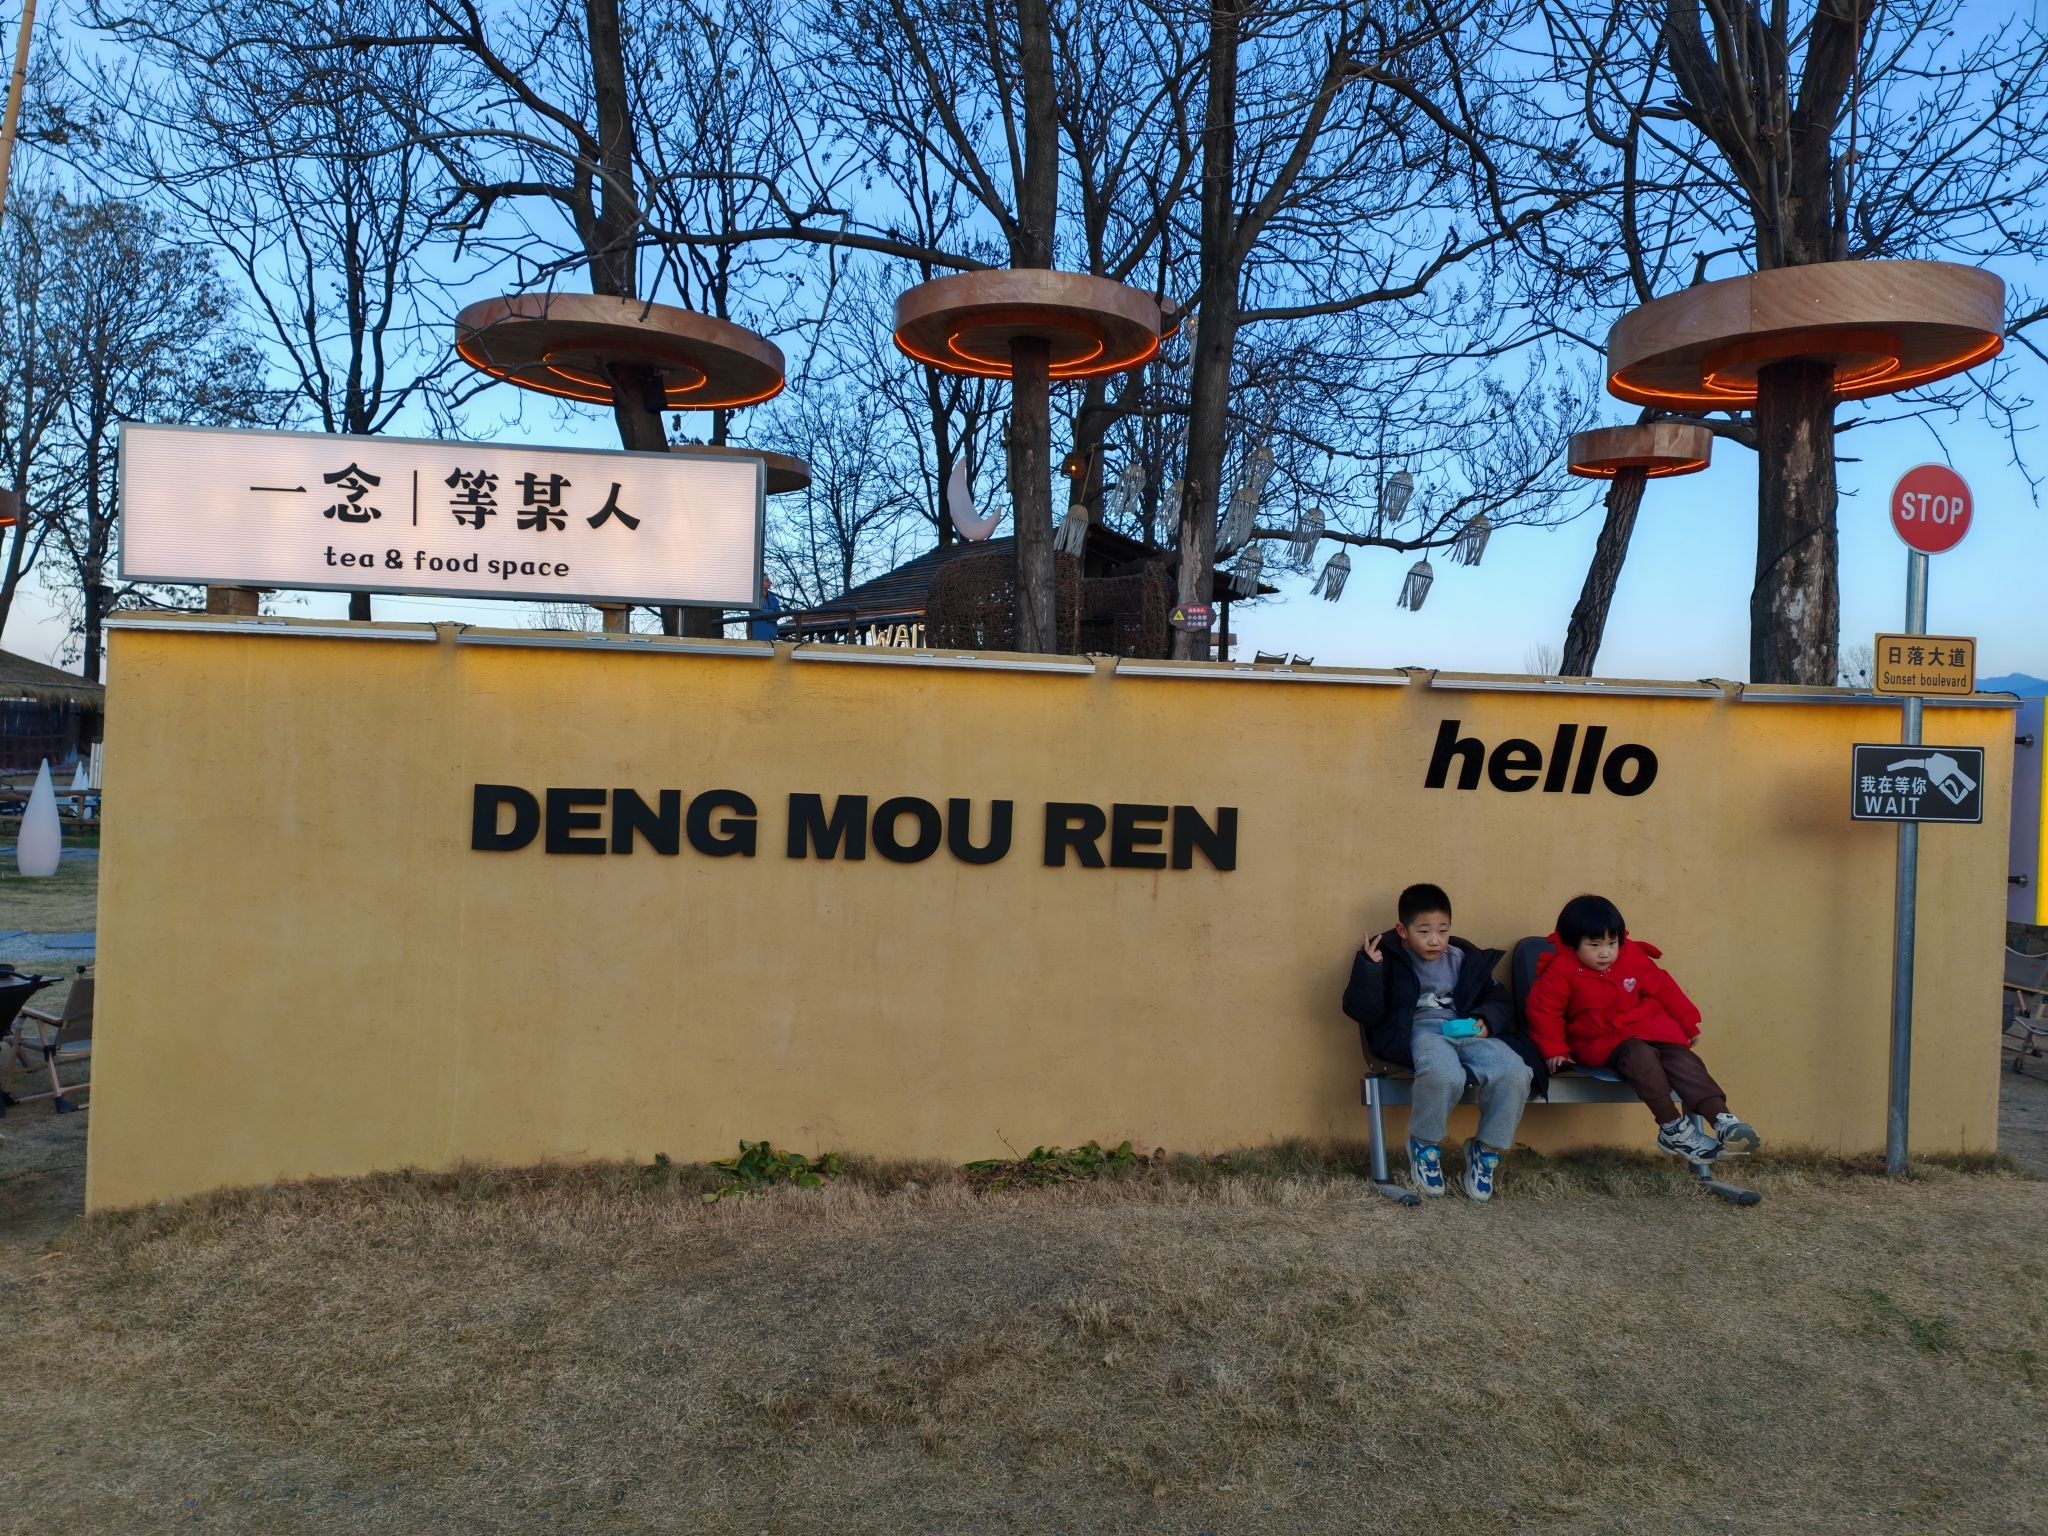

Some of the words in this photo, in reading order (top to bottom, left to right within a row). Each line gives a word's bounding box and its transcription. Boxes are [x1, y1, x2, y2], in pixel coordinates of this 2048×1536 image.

[249, 462, 382, 524] 一念
[444, 467, 641, 532] 等某人
[1901, 491, 1964, 525] STOP
[323, 545, 375, 568] tea
[384, 548, 404, 570] &
[413, 550, 479, 573] food
[487, 558, 570, 580] space
[1888, 645, 1966, 668] 日落大道
[1883, 671, 1916, 686] Sunset
[1920, 672, 1967, 688] boulevard
[1424, 719, 1659, 797] hello
[1861, 775, 1927, 795] 我在等你
[1864, 795, 1920, 815] WAIT
[471, 783, 758, 858] DENG
[786, 792, 1014, 865] MOU
[1043, 801, 1239, 872] REN
